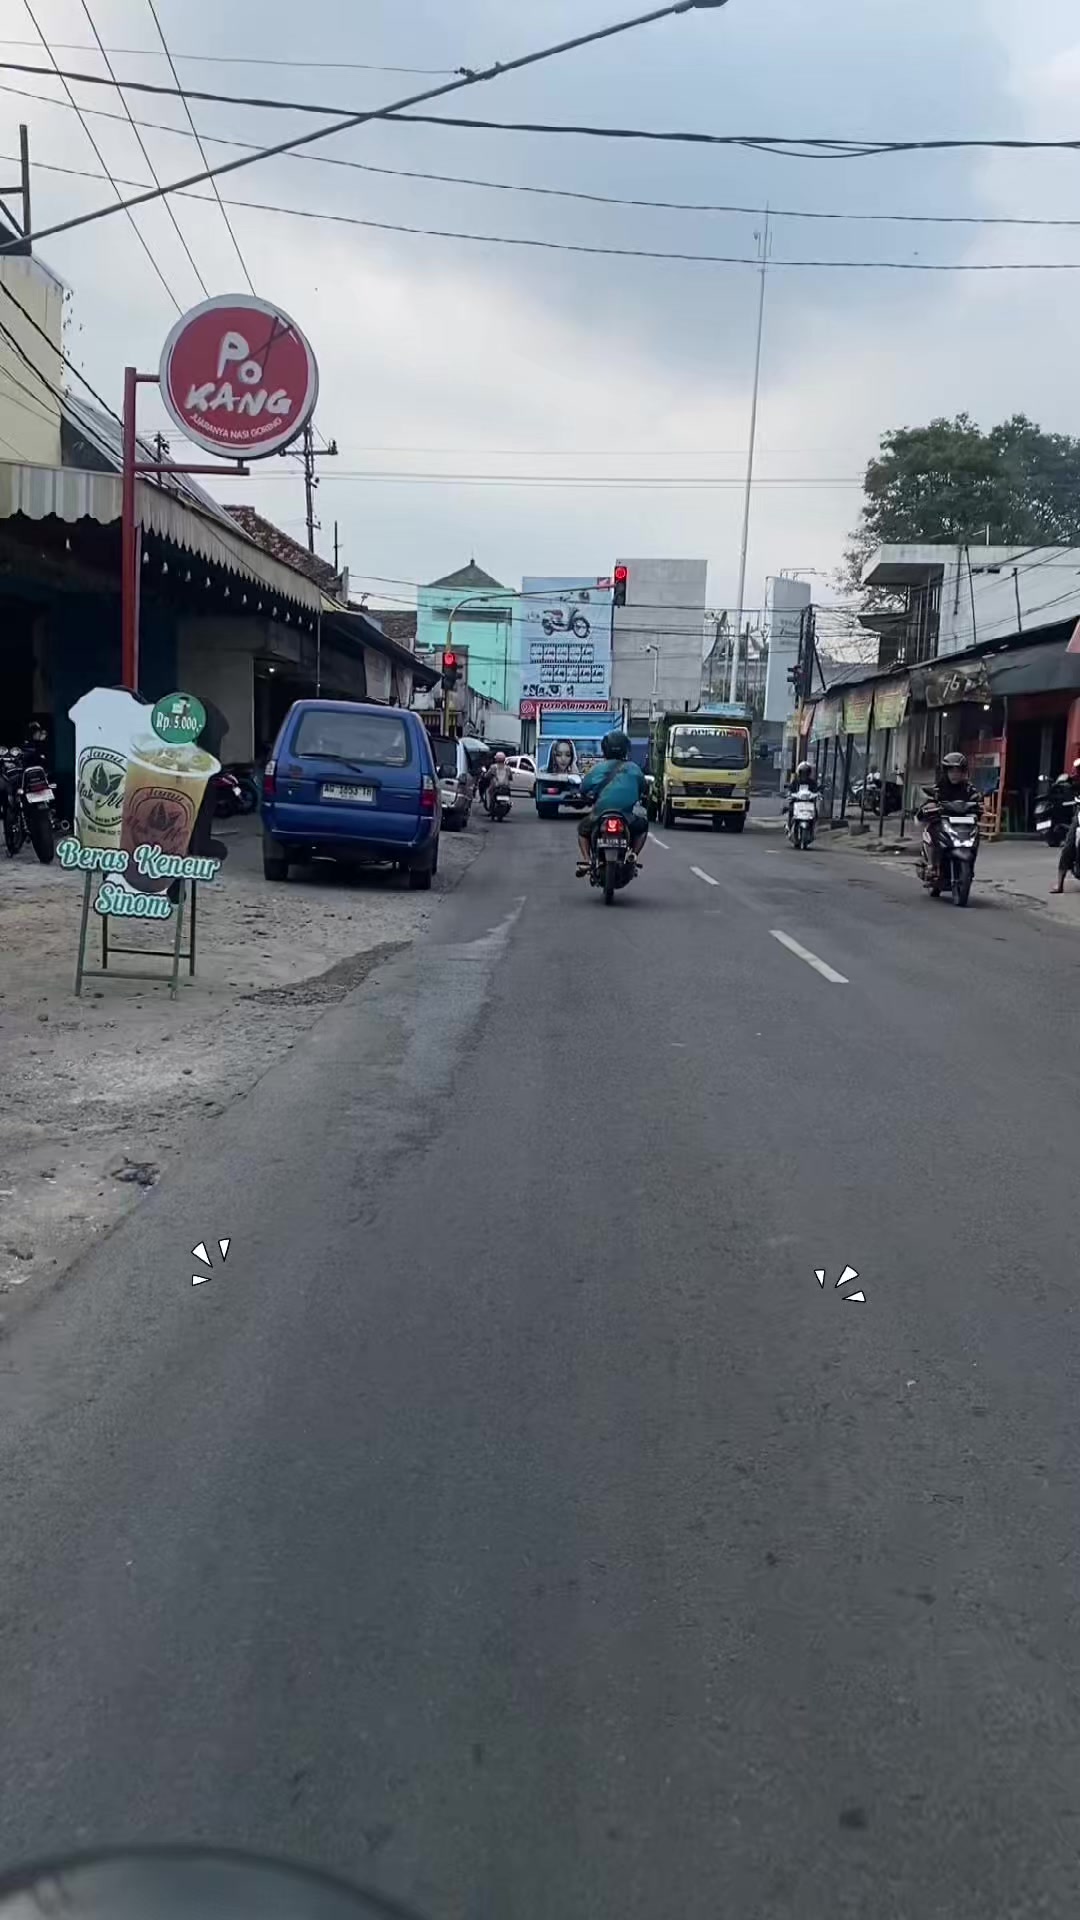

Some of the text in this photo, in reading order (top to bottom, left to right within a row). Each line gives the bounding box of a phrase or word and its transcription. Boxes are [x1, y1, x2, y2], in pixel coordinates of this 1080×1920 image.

[184, 382, 292, 417] KANG
[230, 429, 249, 439] NASI
[57, 839, 221, 879] Beras Kencur
[95, 880, 173, 918] Sinom
